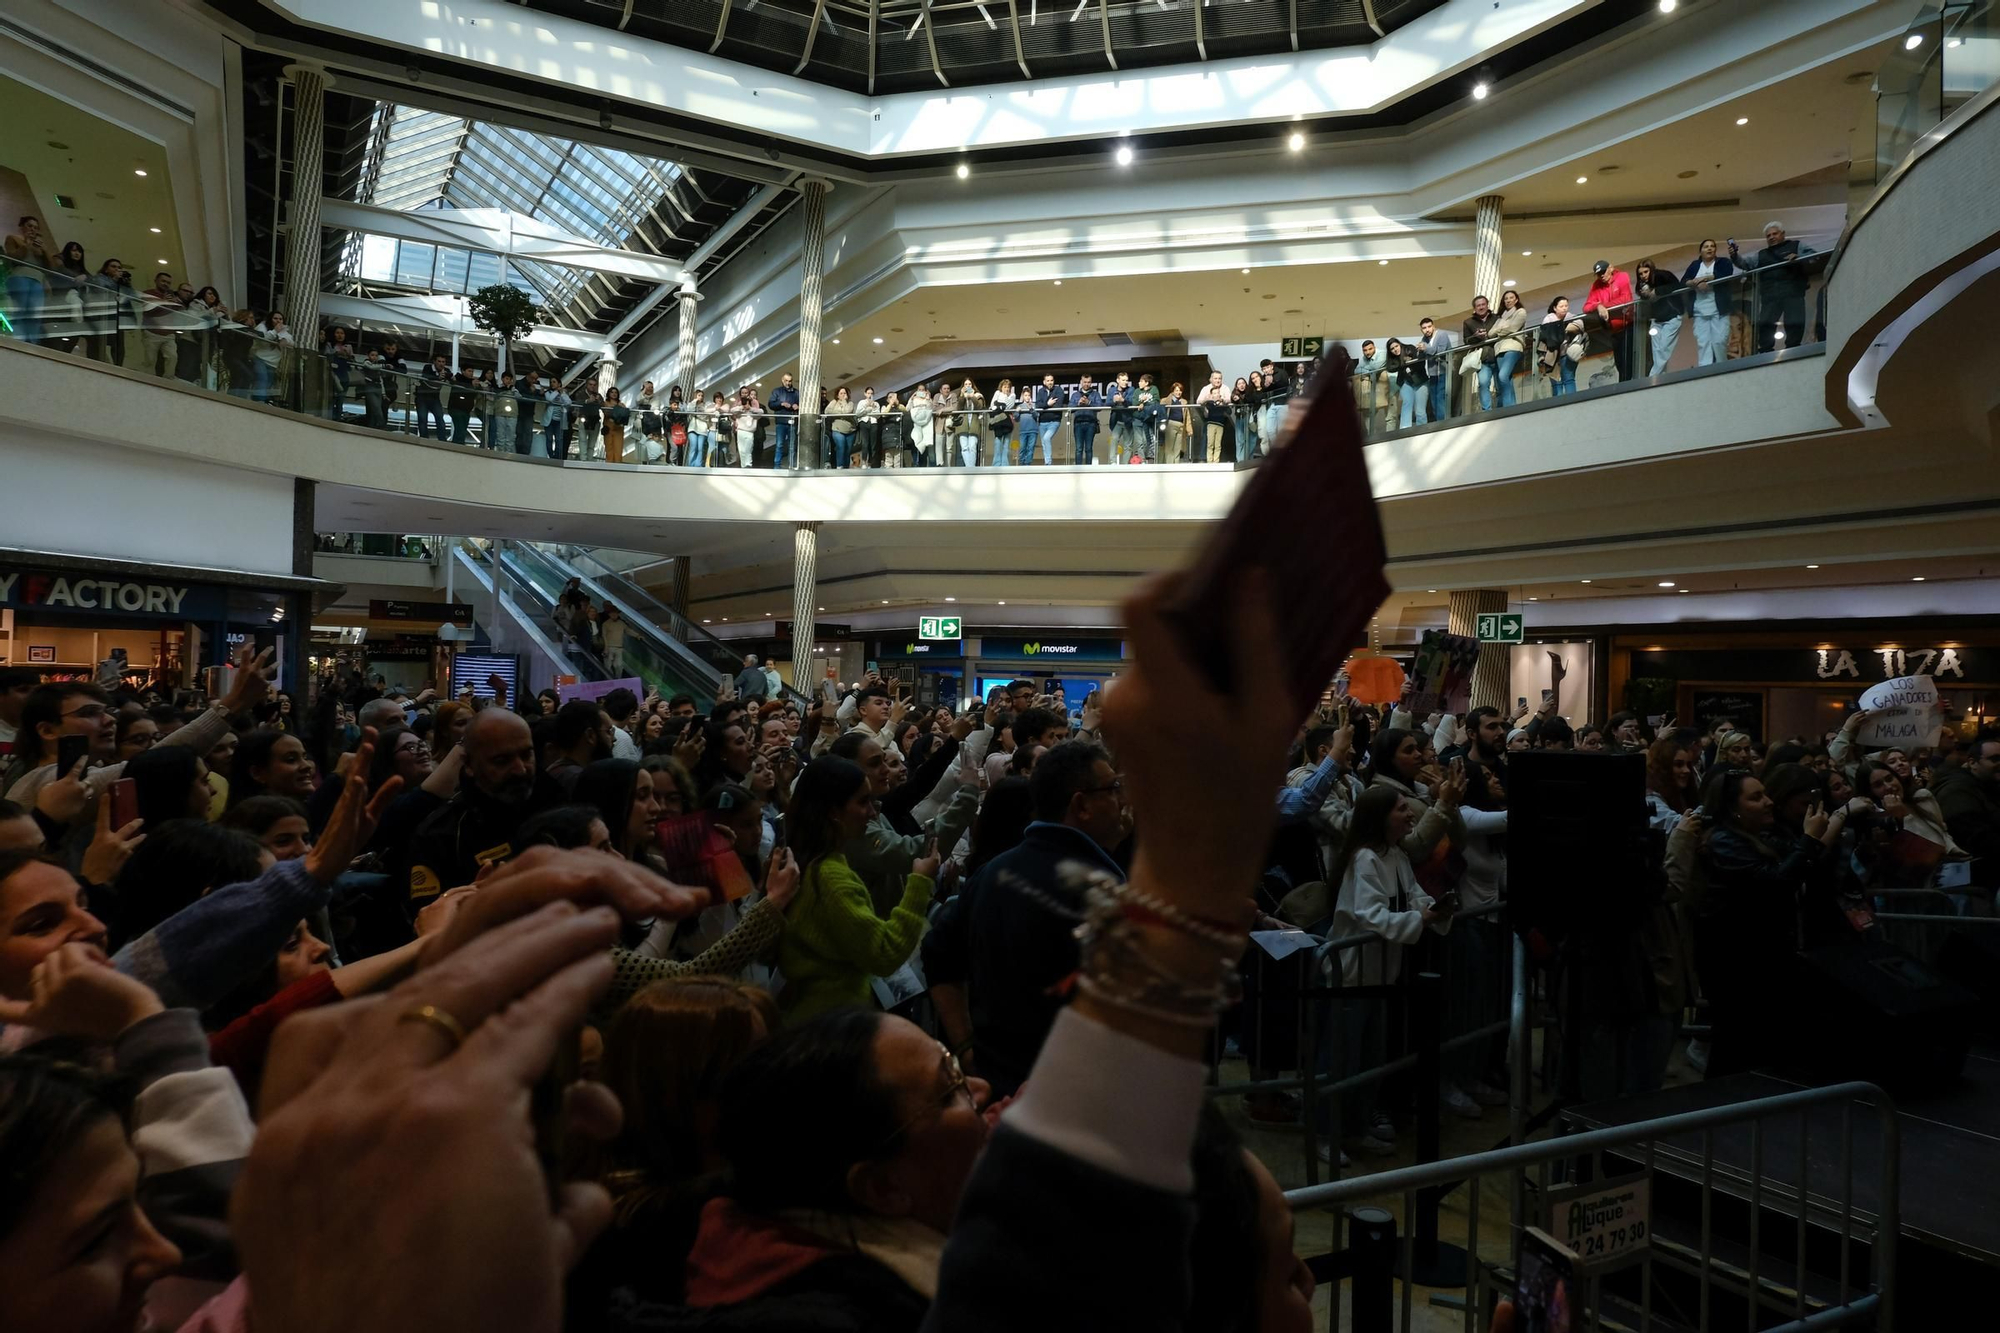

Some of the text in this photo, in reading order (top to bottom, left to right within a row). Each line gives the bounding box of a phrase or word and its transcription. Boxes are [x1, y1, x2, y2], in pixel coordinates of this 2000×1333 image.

[25, 575, 188, 613] FACTORY
[1041, 645, 1078, 654] movistar
[1817, 649, 1965, 679] LA TIZA
[1889, 678, 1914, 690] LOS
[1872, 692, 1932, 708] GANADORES
[1586, 1234, 1604, 1256] 24
[1610, 1228, 1626, 1249] 79
[1630, 1220, 1645, 1242] 30
